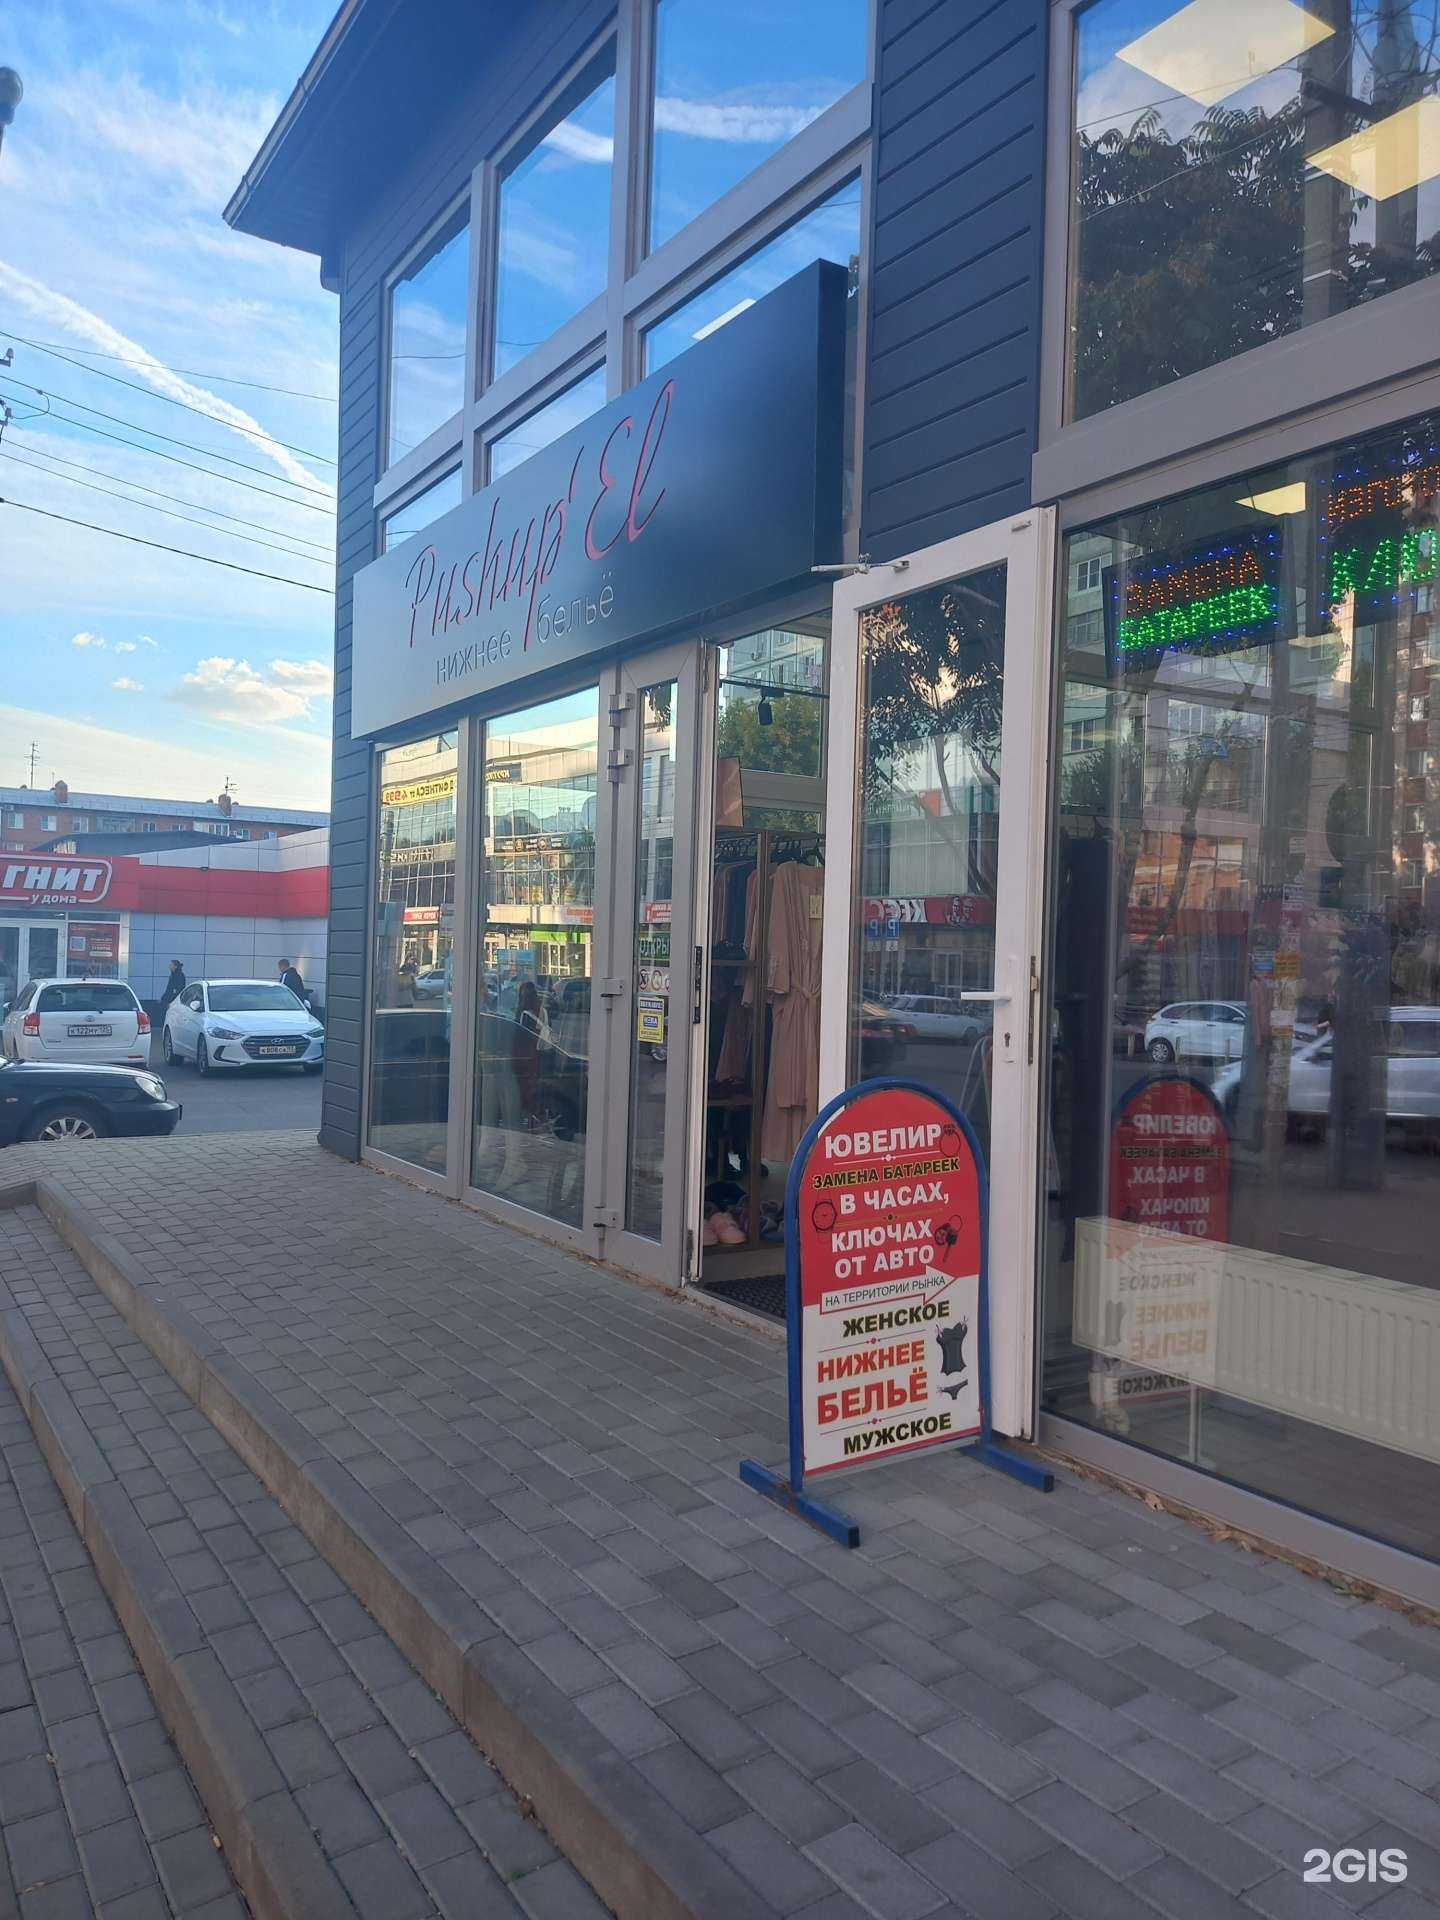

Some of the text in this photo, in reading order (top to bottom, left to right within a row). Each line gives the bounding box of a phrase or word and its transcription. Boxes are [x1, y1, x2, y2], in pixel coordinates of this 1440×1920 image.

[1126, 550, 1261, 615] ЗАМЕНА
[435, 571, 615, 685] нижнее бельё
[1119, 583, 1271, 650] БАТАРЕЕК
[2, 865, 104, 892] ГНИТ
[41, 894, 77, 905] дома
[824, 1124, 942, 1159] ЮВЕЛИР
[813, 1157, 960, 1189] ЗАМЕНА БАТАРЕЕК
[840, 1181, 950, 1215] В ЧАСАХ,
[831, 1218, 934, 1253] КЛЮЧАХ
[834, 1244, 934, 1279] ОТ АВТО
[825, 1276, 946, 1307] НА ТЕРРИТОРИИ РЫНКА
[842, 1300, 950, 1338] ЖЕНСКОЕ
[817, 1339, 925, 1384] НИЖНЕЕ
[817, 1366, 928, 1426] БЕЛЬЁ
[843, 1412, 952, 1455] МУЖСКОЕ
